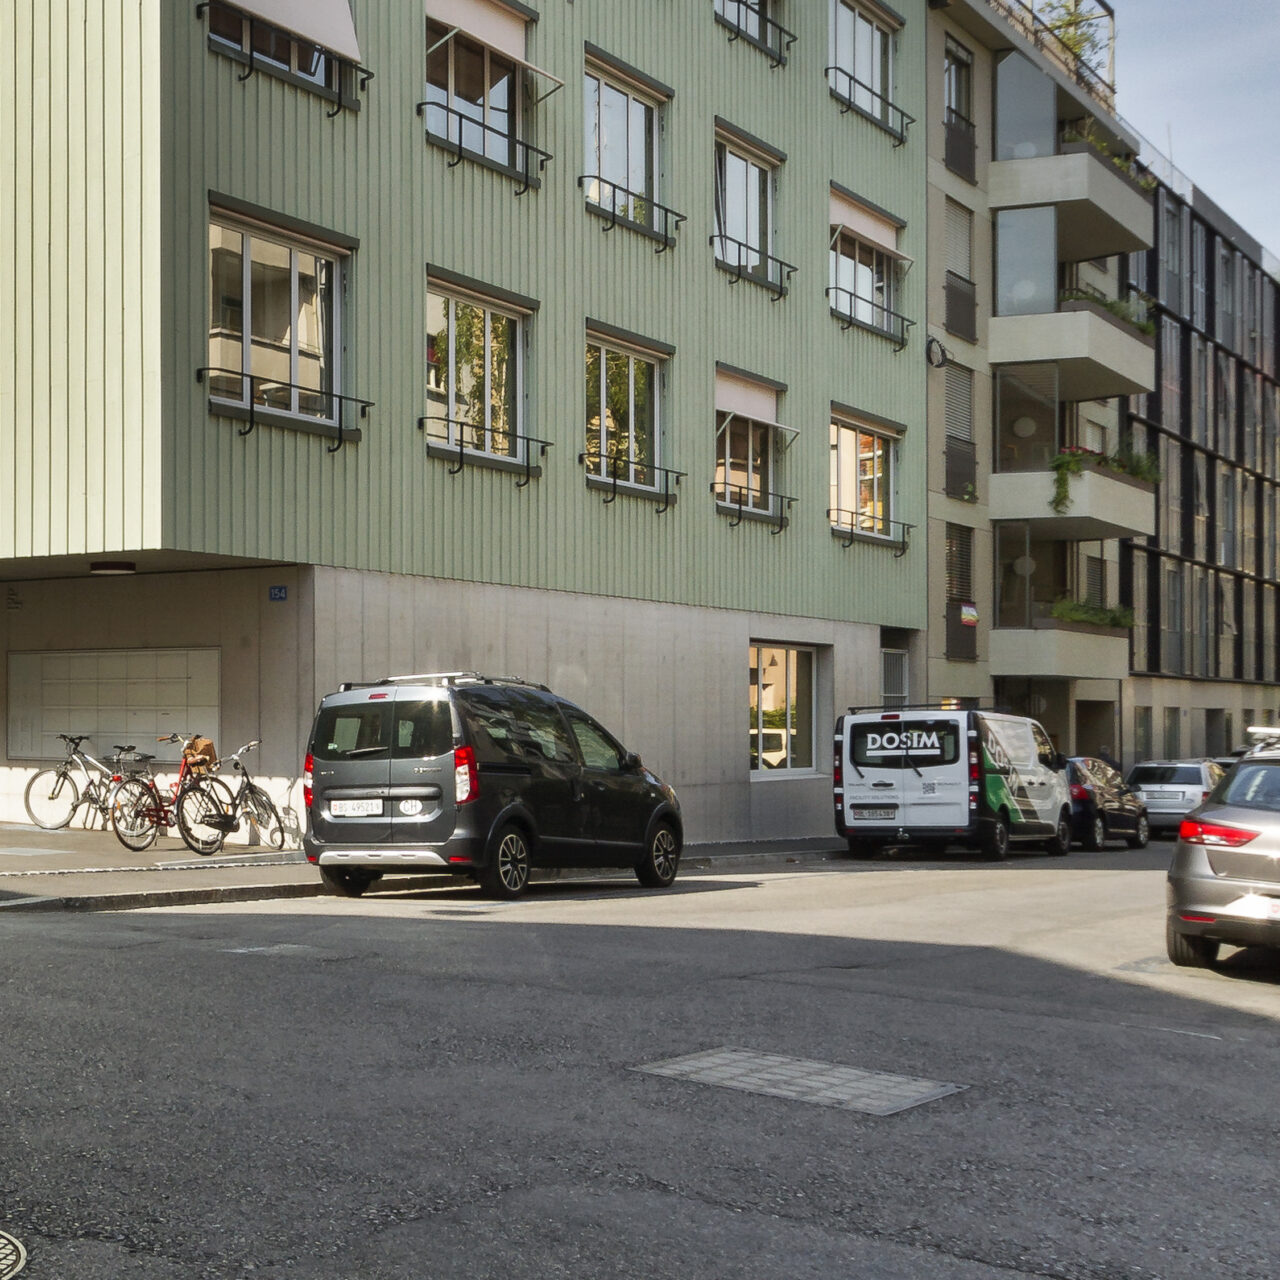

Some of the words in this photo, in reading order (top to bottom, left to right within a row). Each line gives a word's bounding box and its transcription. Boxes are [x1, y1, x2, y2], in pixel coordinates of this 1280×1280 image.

[271, 588, 286, 599] 154
[866, 731, 940, 750] DOSIM
[403, 800, 418, 814] CH
